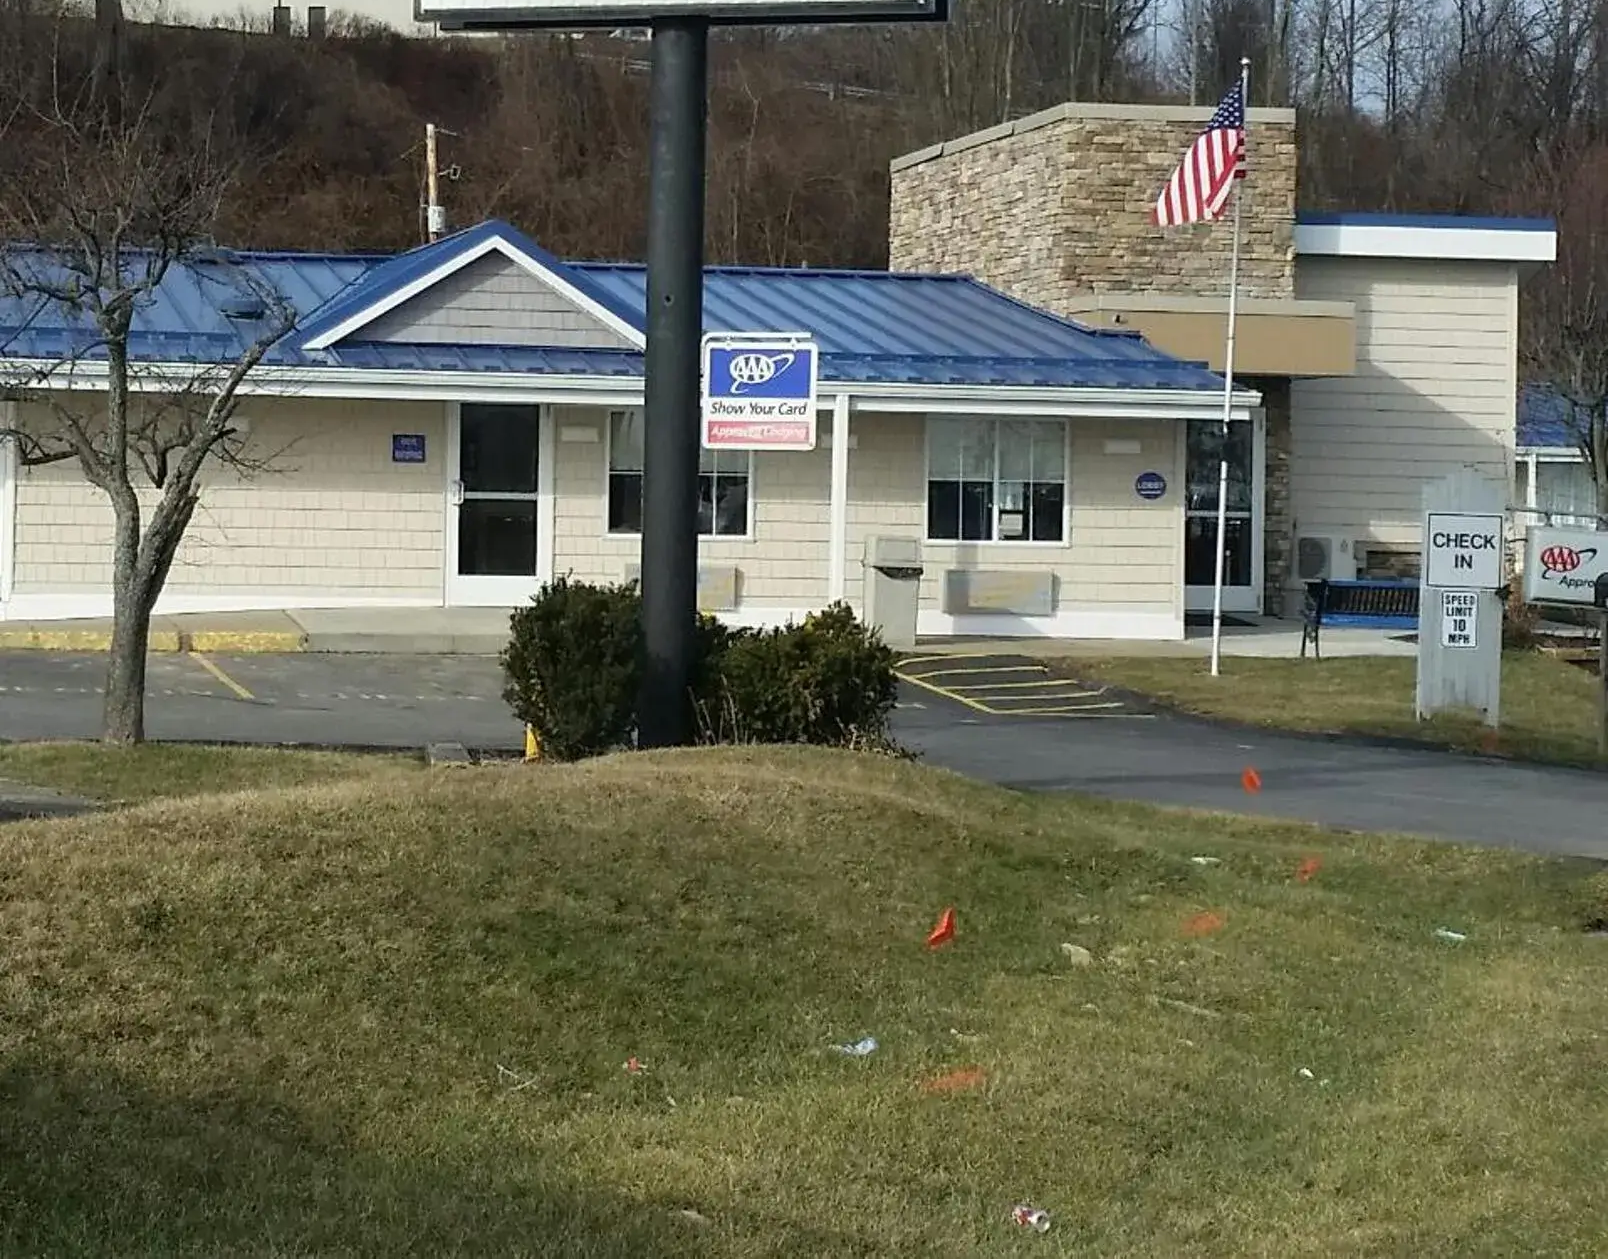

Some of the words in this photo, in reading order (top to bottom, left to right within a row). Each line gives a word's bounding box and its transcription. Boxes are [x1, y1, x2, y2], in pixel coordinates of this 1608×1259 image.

[734, 354, 773, 382] AAA
[710, 402, 746, 416] Show
[749, 402, 776, 416] Your
[778, 402, 808, 416] Card
[1432, 531, 1496, 550] CHECK
[1454, 553, 1473, 569] IN
[1546, 547, 1576, 571] AAA
[1559, 575, 1597, 589] Appro
[1445, 594, 1475, 605] SPEED
[1446, 606, 1473, 617] LIMIT
[1453, 619, 1466, 632] 10
[1448, 633, 1470, 644] MPH
